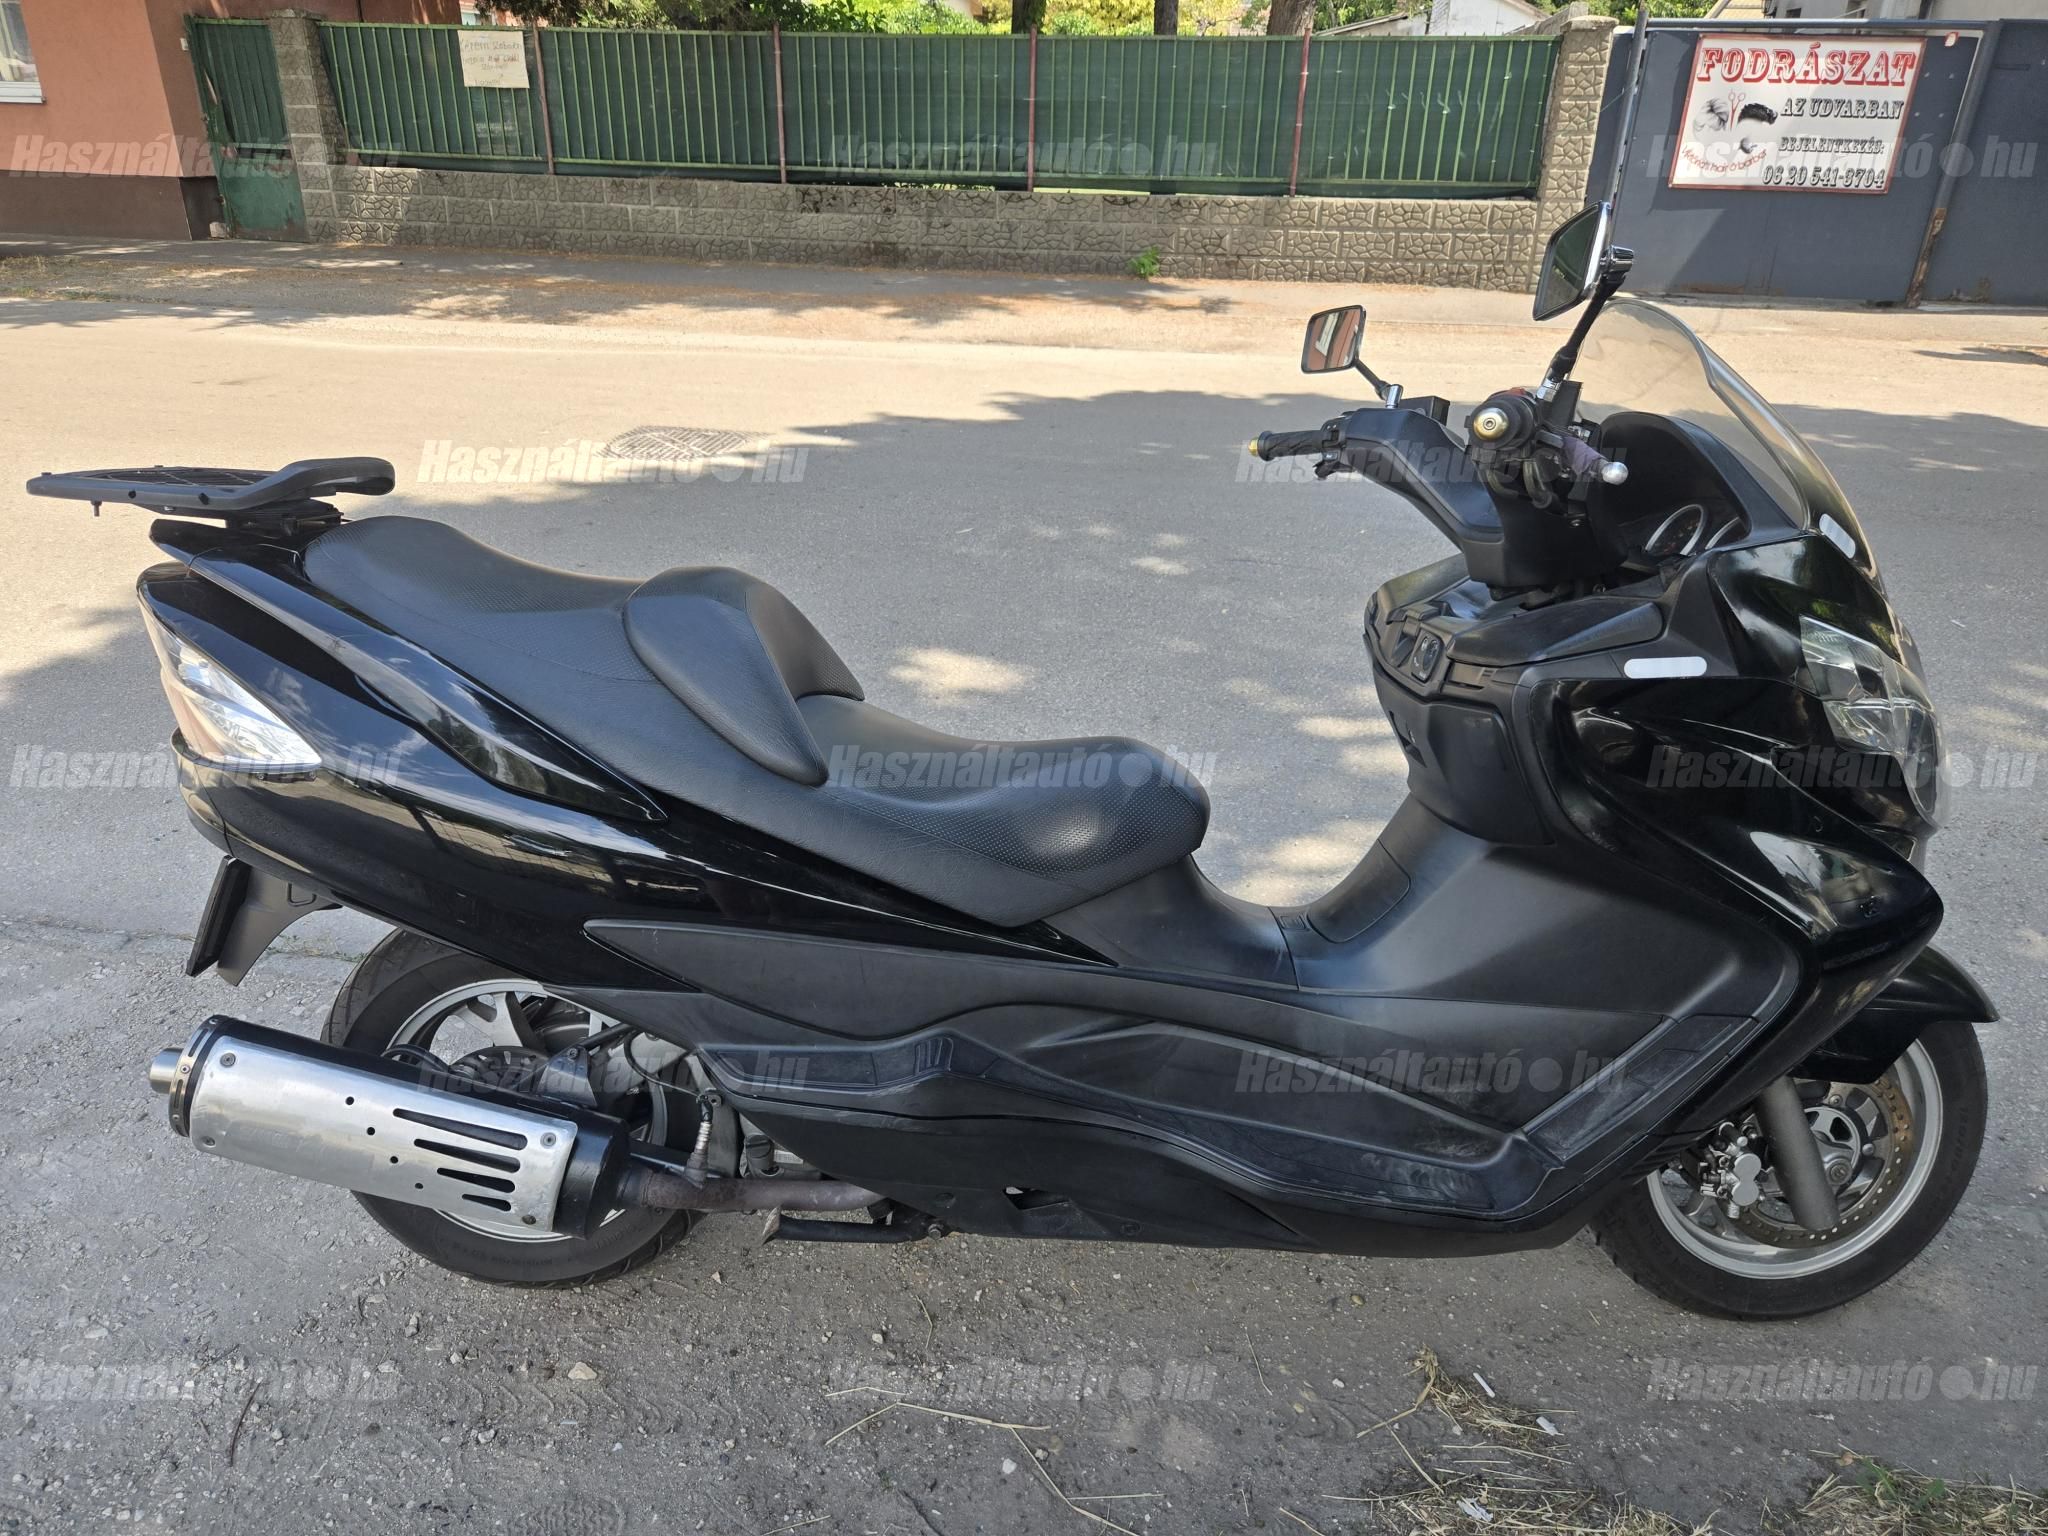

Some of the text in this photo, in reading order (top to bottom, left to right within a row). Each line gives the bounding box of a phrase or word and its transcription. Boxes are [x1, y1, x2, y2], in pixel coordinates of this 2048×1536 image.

[1697, 42, 1916, 87] FODRÁSZAT
[1780, 98, 1904, 119] AZ UDVARBAN
[1778, 136, 1885, 154] BEJELENTKEZÉS:
[1762, 165, 1784, 185] 06
[1785, 166, 1808, 186] 20
